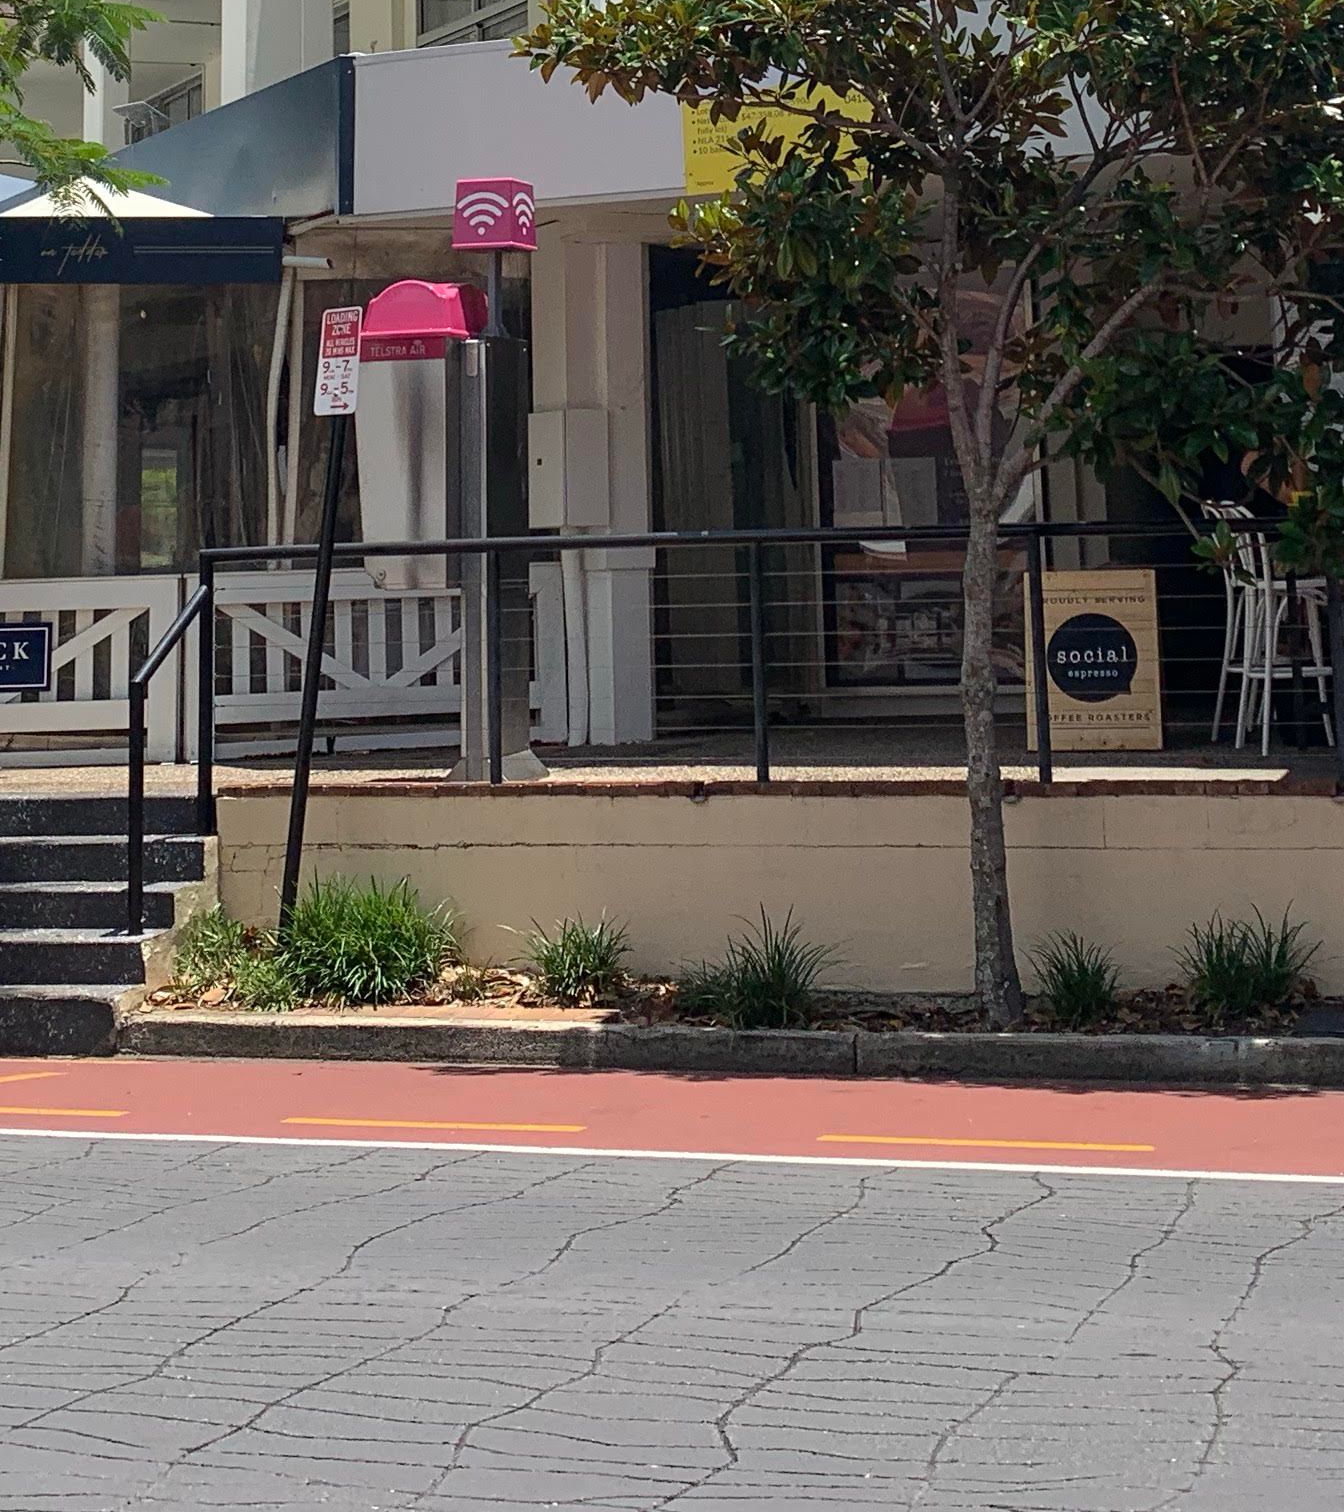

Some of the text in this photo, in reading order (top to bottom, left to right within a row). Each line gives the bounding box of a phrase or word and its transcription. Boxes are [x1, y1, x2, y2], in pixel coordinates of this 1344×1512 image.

[326, 310, 359, 325] LOADING
[331, 323, 352, 336] ZONE
[370, 343, 427, 358] TELSTRA AIR
[1056, 646, 1130, 664] social
[1067, 669, 1119, 679] espresso
[1087, 711, 1151, 722] ROASTERS
